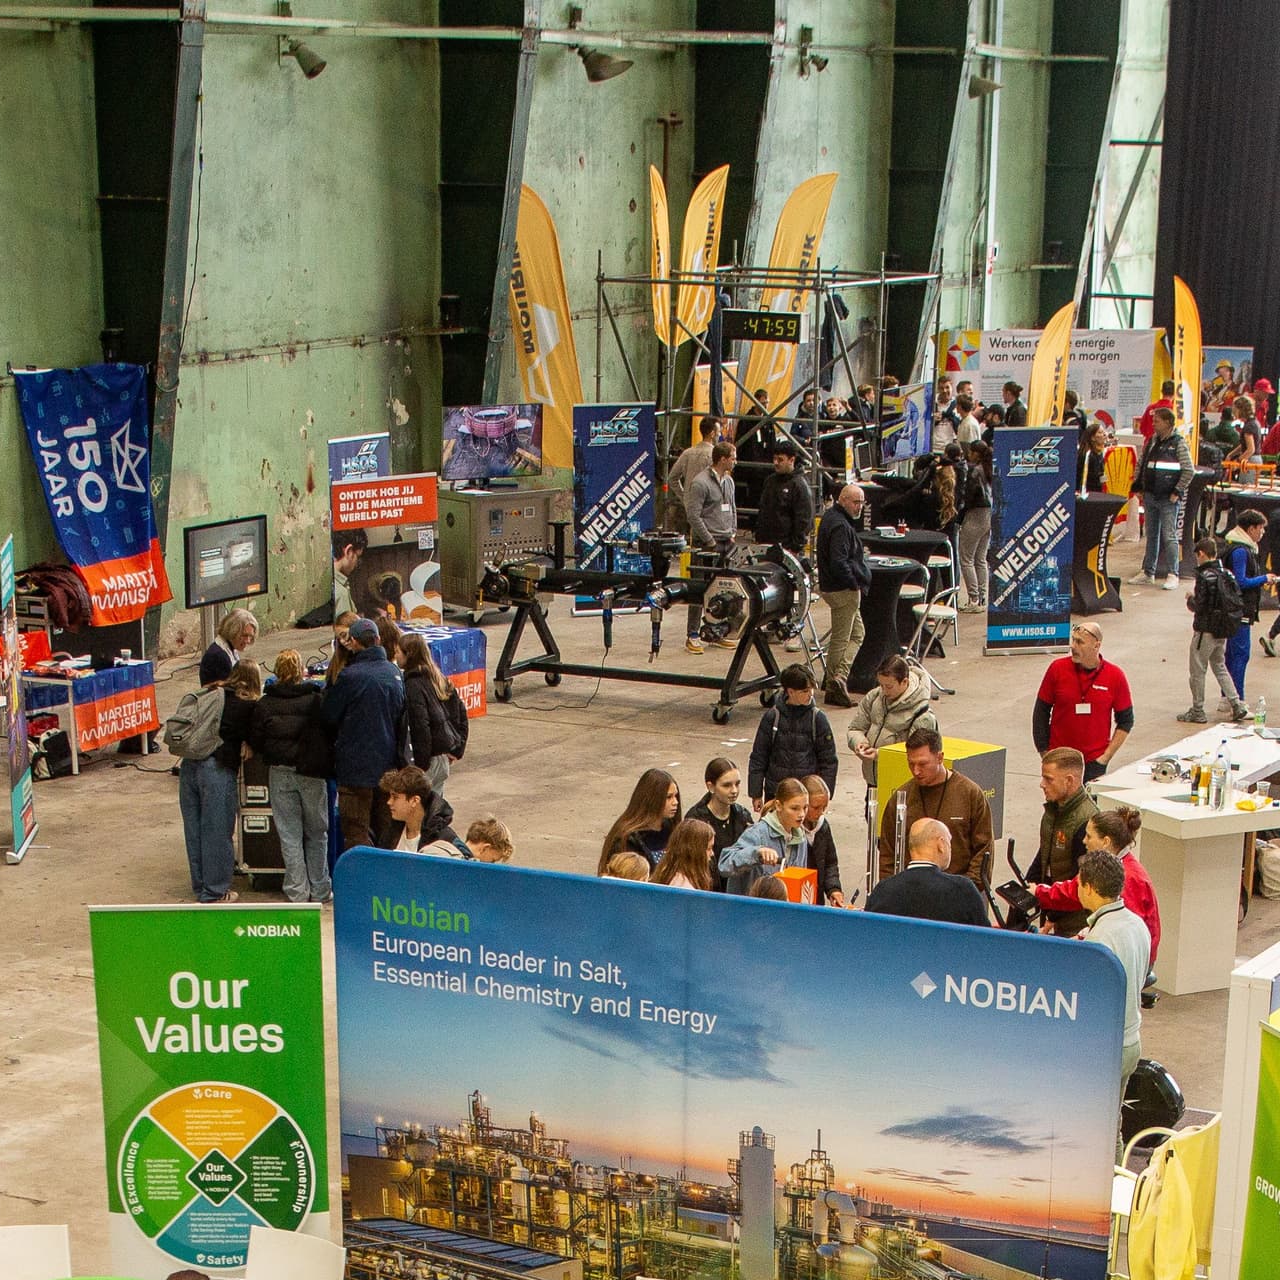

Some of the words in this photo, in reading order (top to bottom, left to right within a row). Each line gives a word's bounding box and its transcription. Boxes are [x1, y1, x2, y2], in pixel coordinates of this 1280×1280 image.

[988, 352, 1009, 363] van
[1078, 351, 1121, 364] morgen
[989, 336, 1032, 350] Werken
[1074, 337, 1116, 351] energie
[36, 430, 75, 519] JAAR
[63, 417, 109, 514] 150
[339, 488, 378, 501] ONTDEK
[379, 486, 400, 497] HOE
[401, 485, 415, 496] JIJ
[339, 501, 355, 512] BIJ
[356, 500, 369, 510] DE
[371, 495, 424, 509] MARITIEME
[579, 471, 652, 548] WELCOME
[339, 510, 379, 523] WERELD
[380, 508, 405, 519] PAST
[993, 501, 1072, 585] WELCOME
[1097, 513, 1115, 571] MOURIK
[97, 697, 151, 725] MARITIEM
[246, 924, 301, 939] NOBIAN
[371, 895, 471, 935] Nobian
[372, 930, 472, 966] European
[479, 944, 547, 976] leader
[553, 955, 573, 979] in
[578, 959, 628, 990] Salt,
[168, 971, 250, 1010] Our
[373, 961, 468, 994] Essential
[474, 975, 584, 1015] Chemistry
[589, 995, 632, 1019] and
[639, 999, 718, 1035] Energy
[944, 973, 1079, 1021] NOBIAN
[134, 1015, 286, 1054] Values
[204, 1088, 233, 1100] Care
[123, 1141, 140, 1206] Excellence
[198, 1172, 234, 1183] Values
[206, 1162, 225, 1173] Our
[291, 1150, 308, 1214] Ownership
[207, 1253, 245, 1267] Safety
